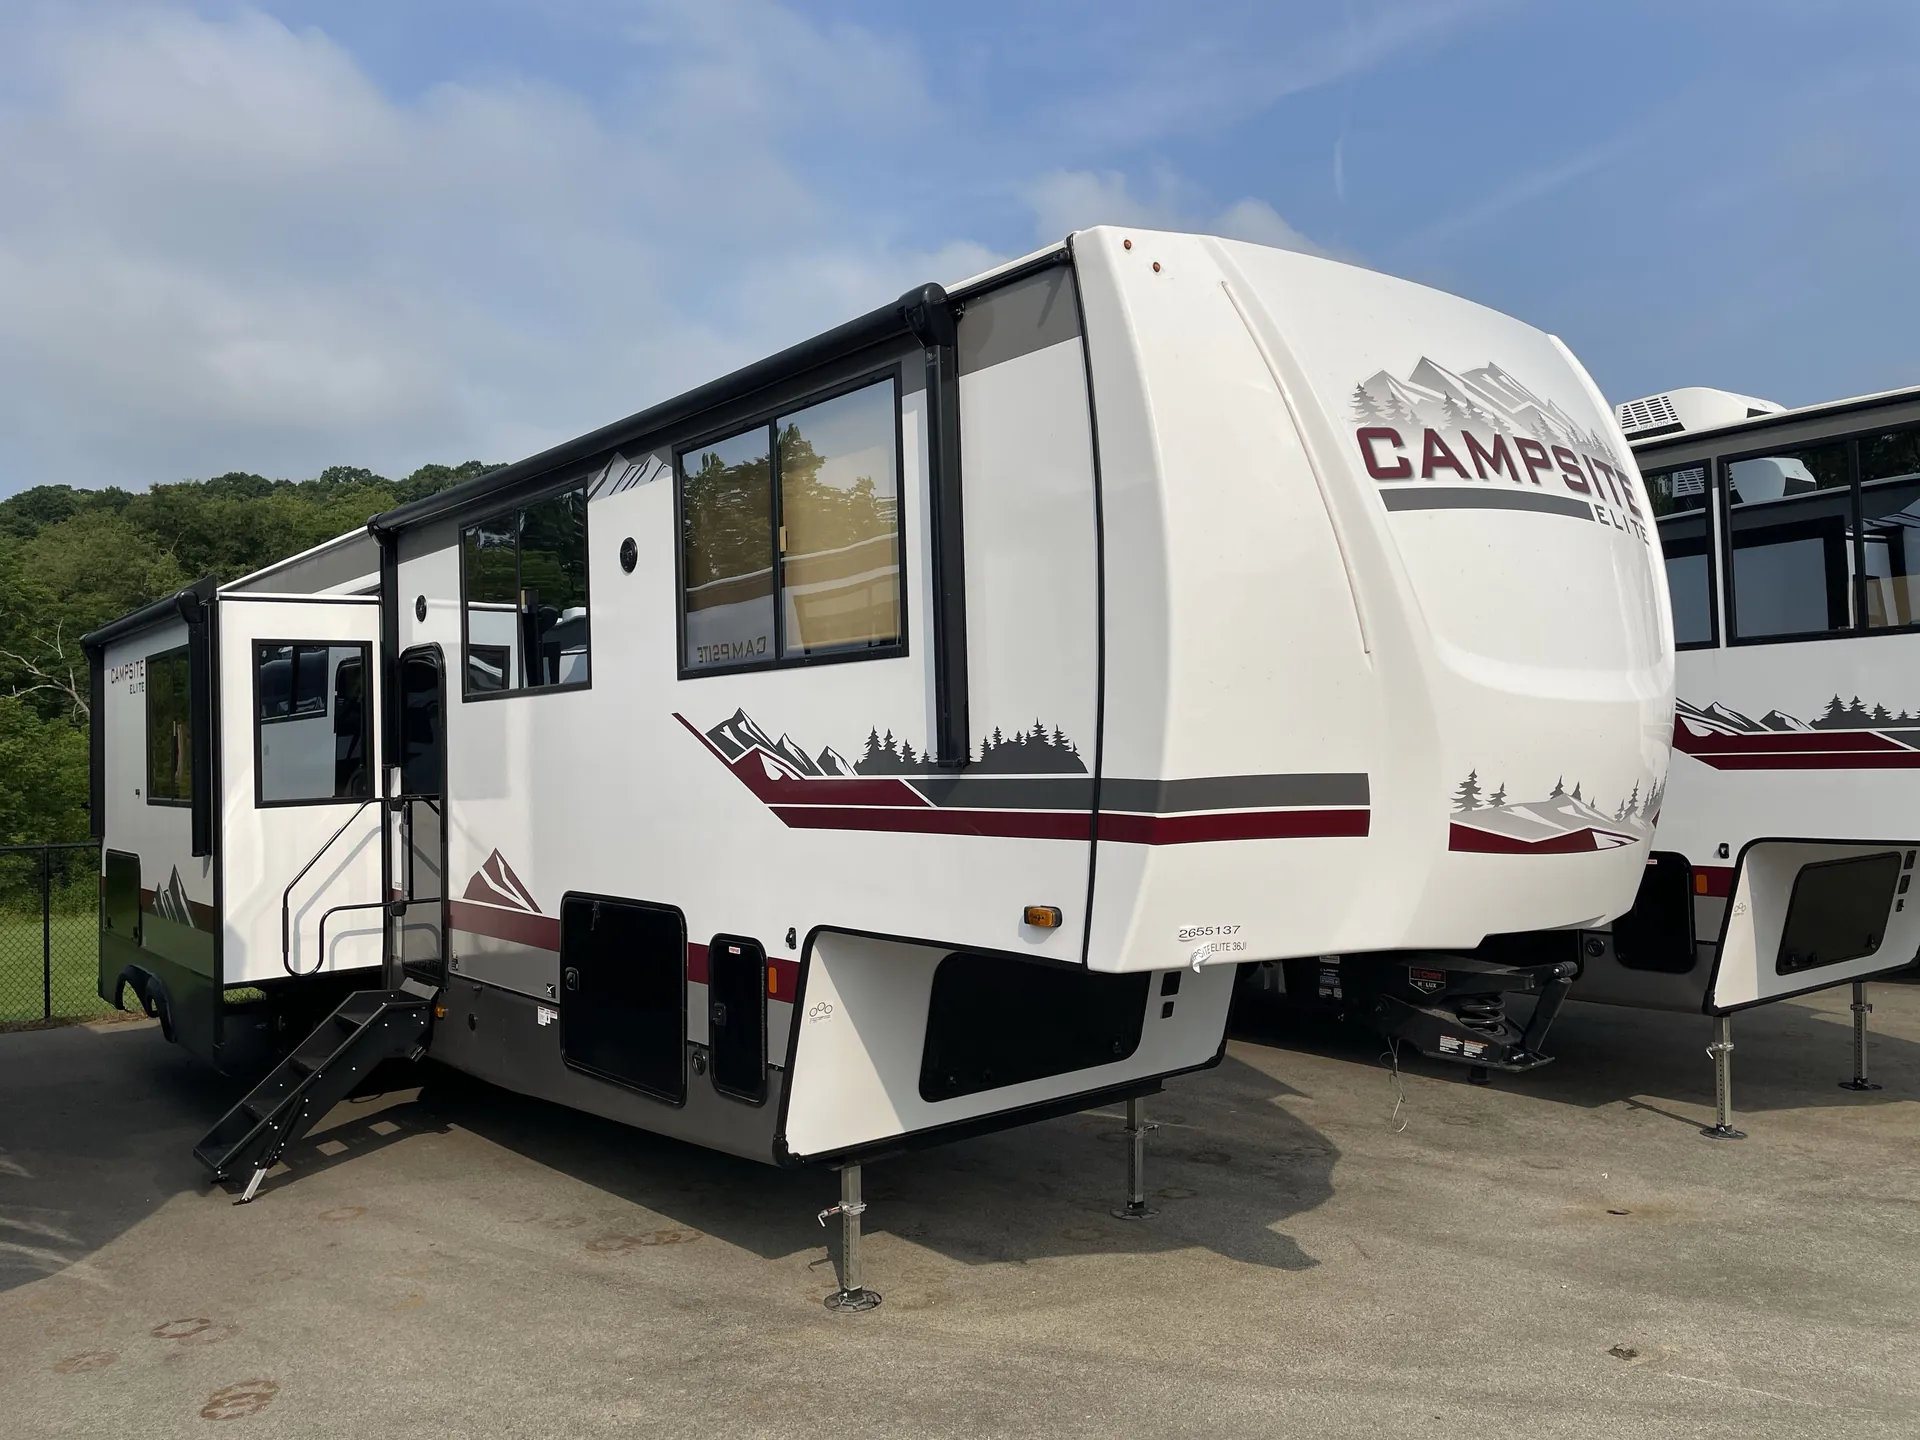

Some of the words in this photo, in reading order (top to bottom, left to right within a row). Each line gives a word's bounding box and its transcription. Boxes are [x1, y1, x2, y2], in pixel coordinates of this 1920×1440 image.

[1356, 426, 1644, 519] CAMPSITE
[1593, 503, 1651, 547] ELITE
[111, 660, 144, 684] CAMPSITE
[130, 682, 144, 694] ELITE
[1178, 925, 1241, 939] 2655137
[1211, 942, 1231, 952] ELITE
